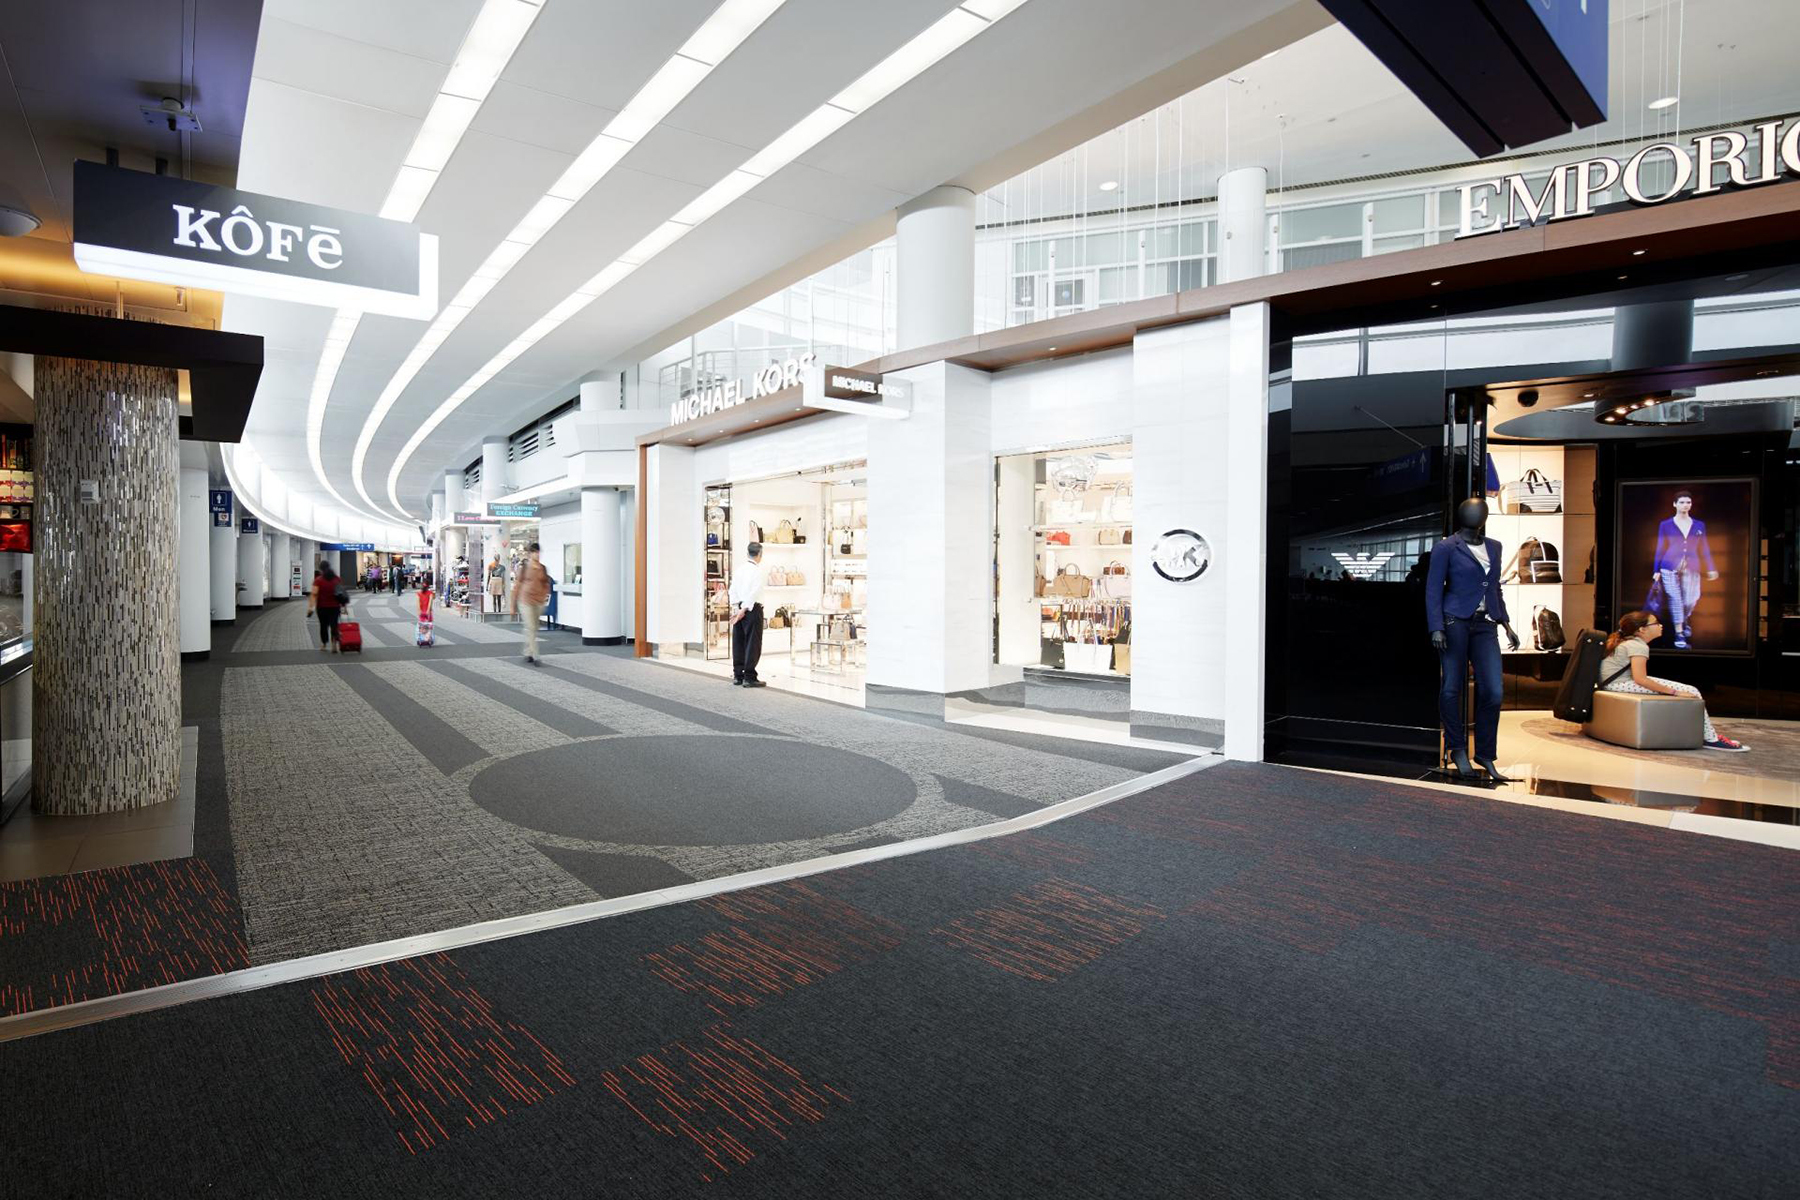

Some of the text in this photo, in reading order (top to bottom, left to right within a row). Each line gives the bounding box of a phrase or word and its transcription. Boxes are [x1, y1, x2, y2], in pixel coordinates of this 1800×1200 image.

[670, 351, 816, 427] MICHAEL KORS
[832, 375, 877, 394] MICHAEL
[513, 504, 539, 512] Currency
